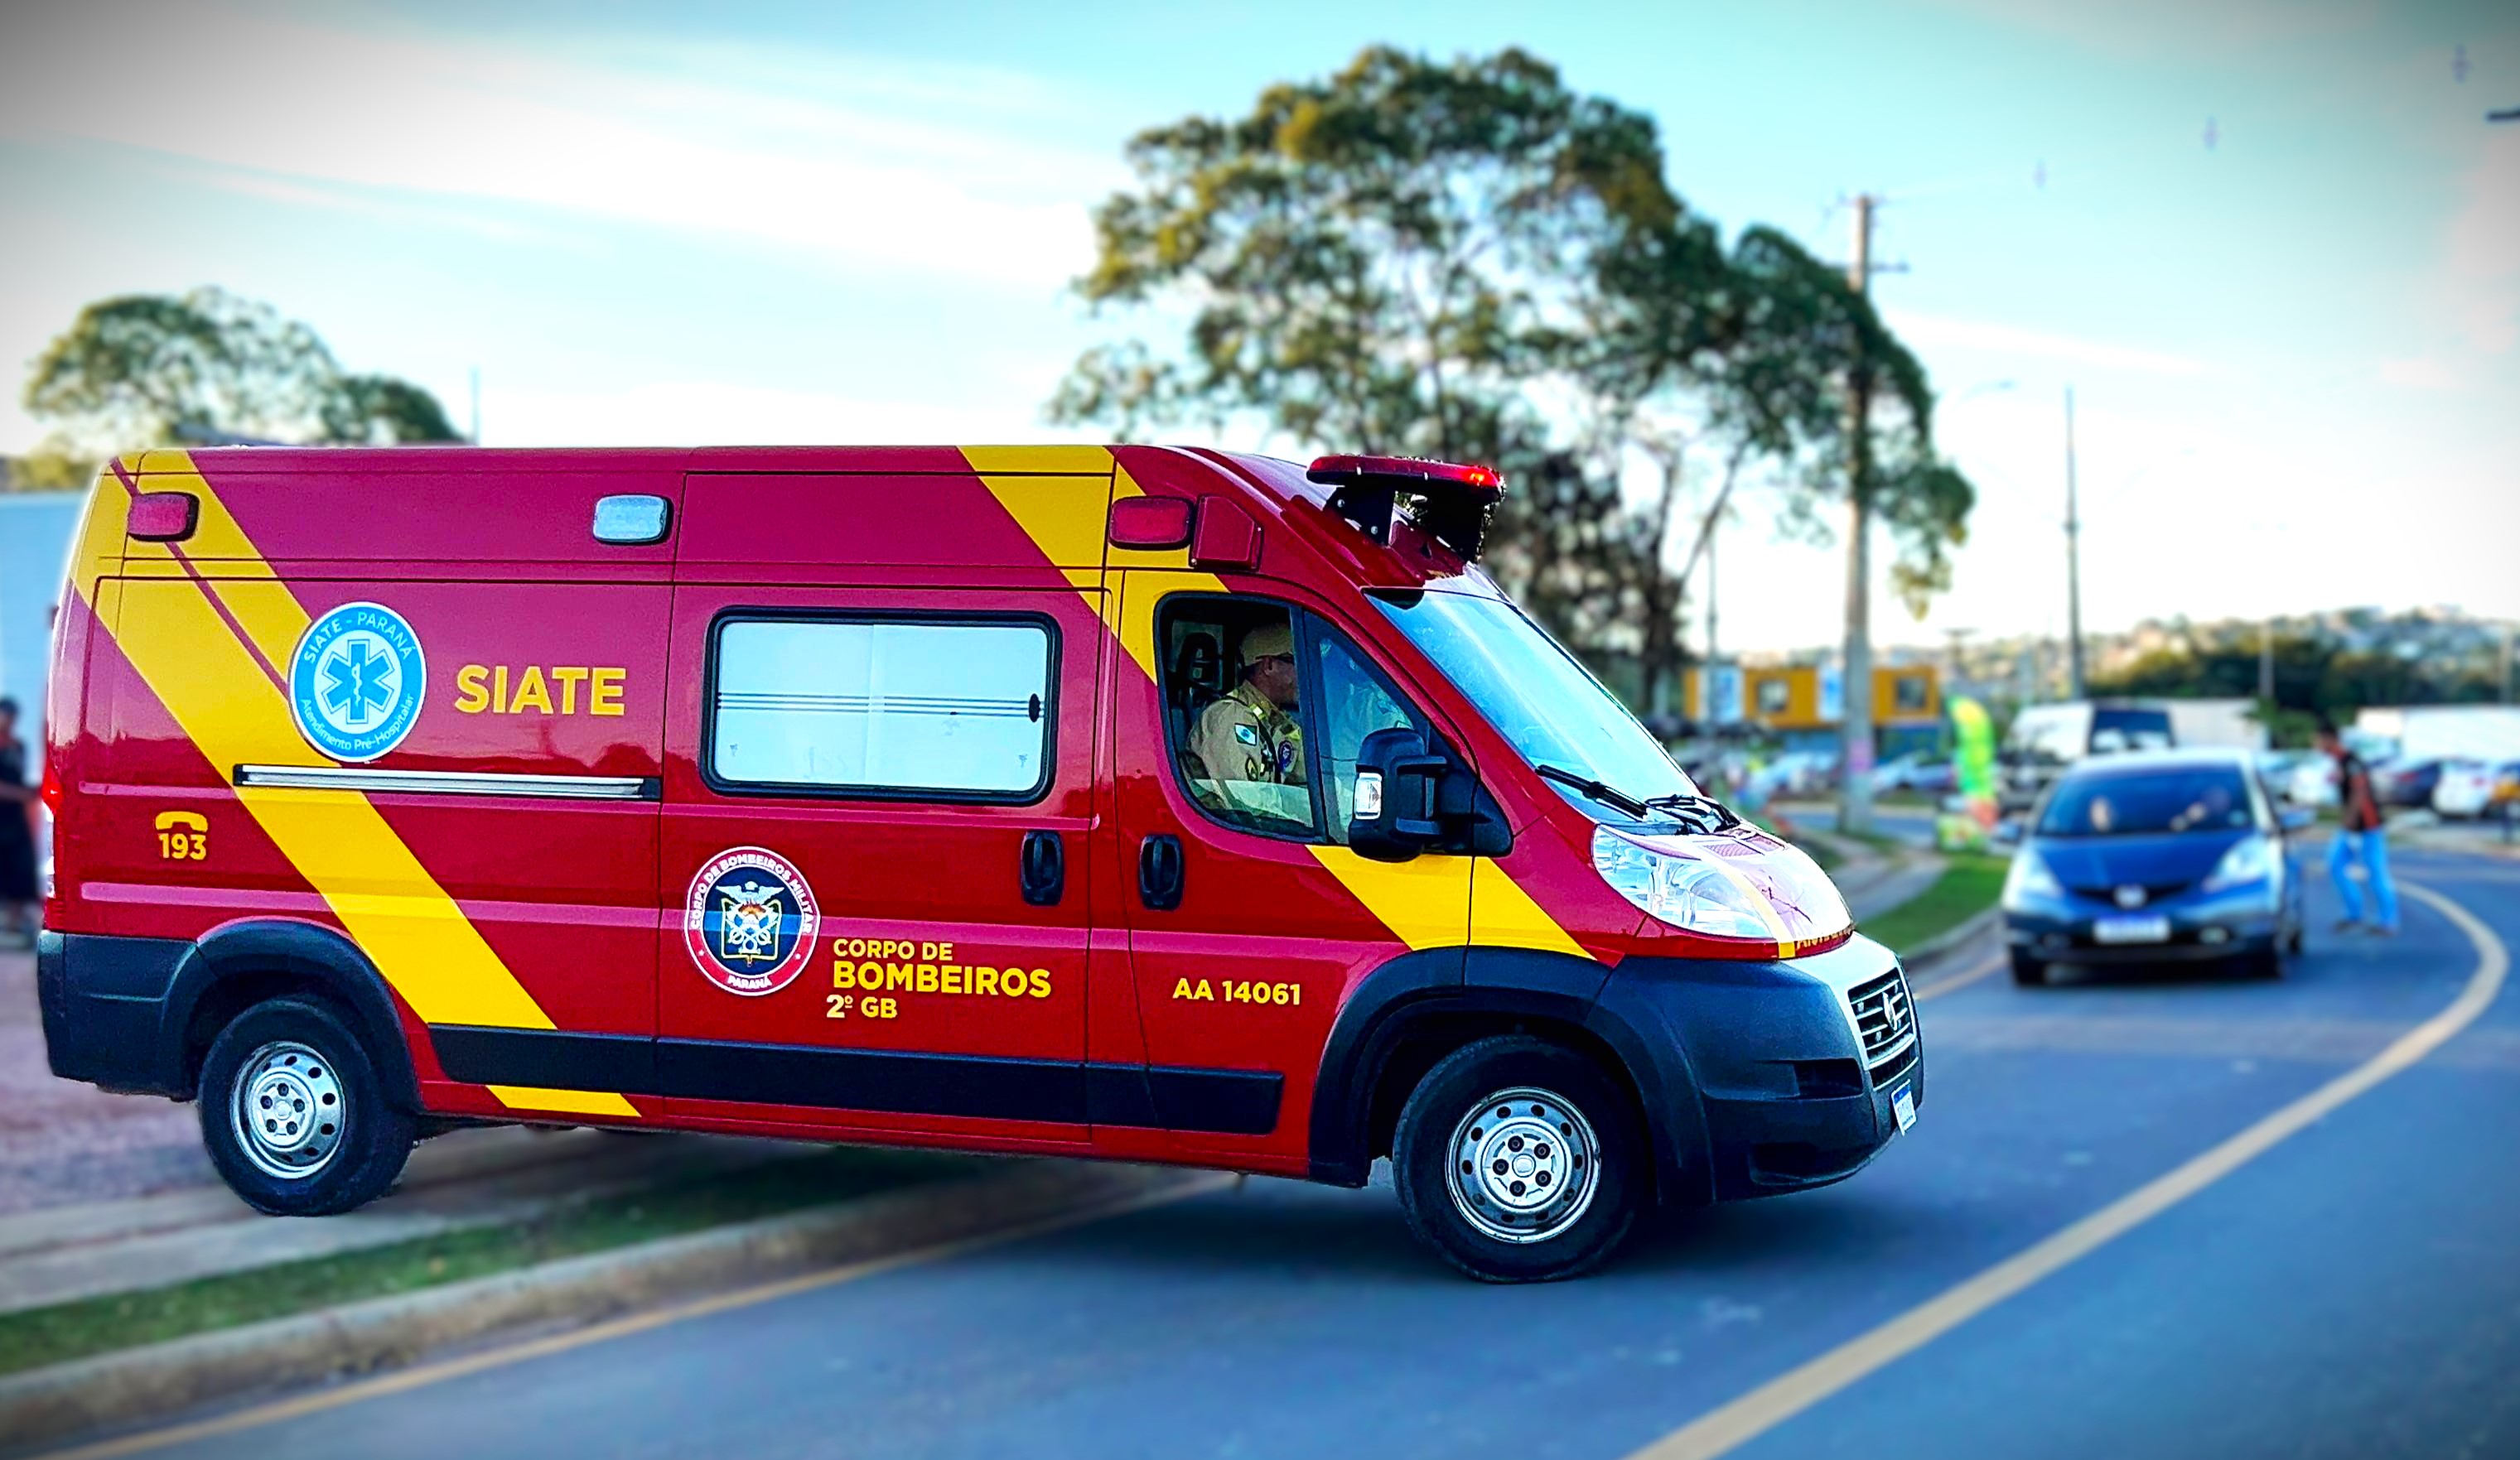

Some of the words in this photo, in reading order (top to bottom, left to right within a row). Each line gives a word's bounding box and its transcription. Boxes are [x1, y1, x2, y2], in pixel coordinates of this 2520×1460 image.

[304, 618, 343, 663] SIATE
[357, 611, 416, 660] PARANÁ
[454, 664, 627, 716] SIATE
[301, 698, 351, 750] Atendimento
[354, 693, 414, 750] Pré-Hospitalar
[158, 832, 206, 860] 193
[690, 880, 708, 929] CORPO
[703, 865, 722, 884] DE
[720, 854, 793, 881] BOMBEIROS
[788, 879, 815, 933] MILITAR
[833, 938, 915, 960] CORPO
[922, 942, 953, 961] DE
[727, 974, 773, 990] PARANÁ
[833, 960, 1052, 998] BOMBEIROS
[1172, 977, 1214, 1001] AA
[1222, 981, 1300, 1005] 14061
[826, 994, 854, 1018] 2º
[861, 996, 898, 1019] GB
